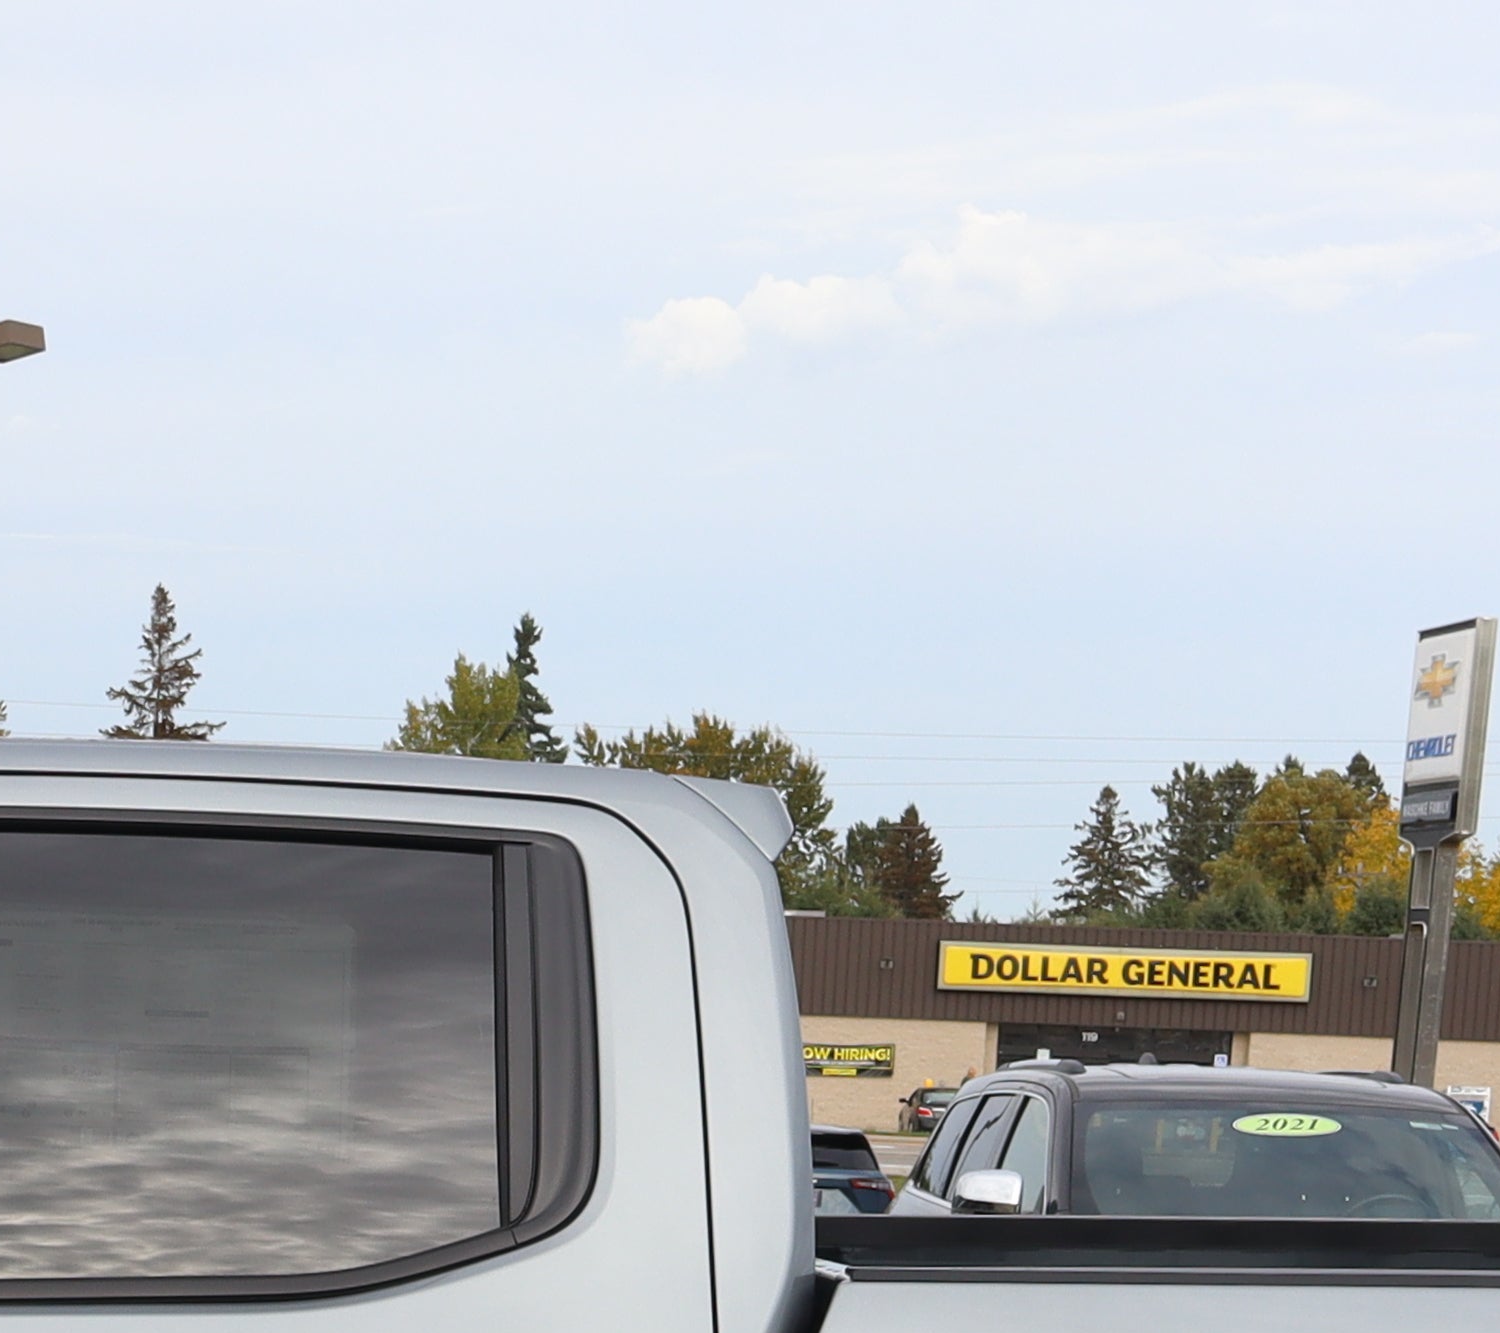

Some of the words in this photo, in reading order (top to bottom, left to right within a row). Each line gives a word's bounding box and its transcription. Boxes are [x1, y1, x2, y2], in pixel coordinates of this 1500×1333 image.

[1406, 734, 1457, 761] CHEVROLET
[969, 953, 1109, 985] DOLLAR
[1121, 958, 1281, 991] GENERAL
[1082, 1031, 1099, 1042] 119
[803, 1046, 831, 1060] OW
[834, 1047, 891, 1061] HIRING!
[1255, 1117, 1320, 1131] 2021
